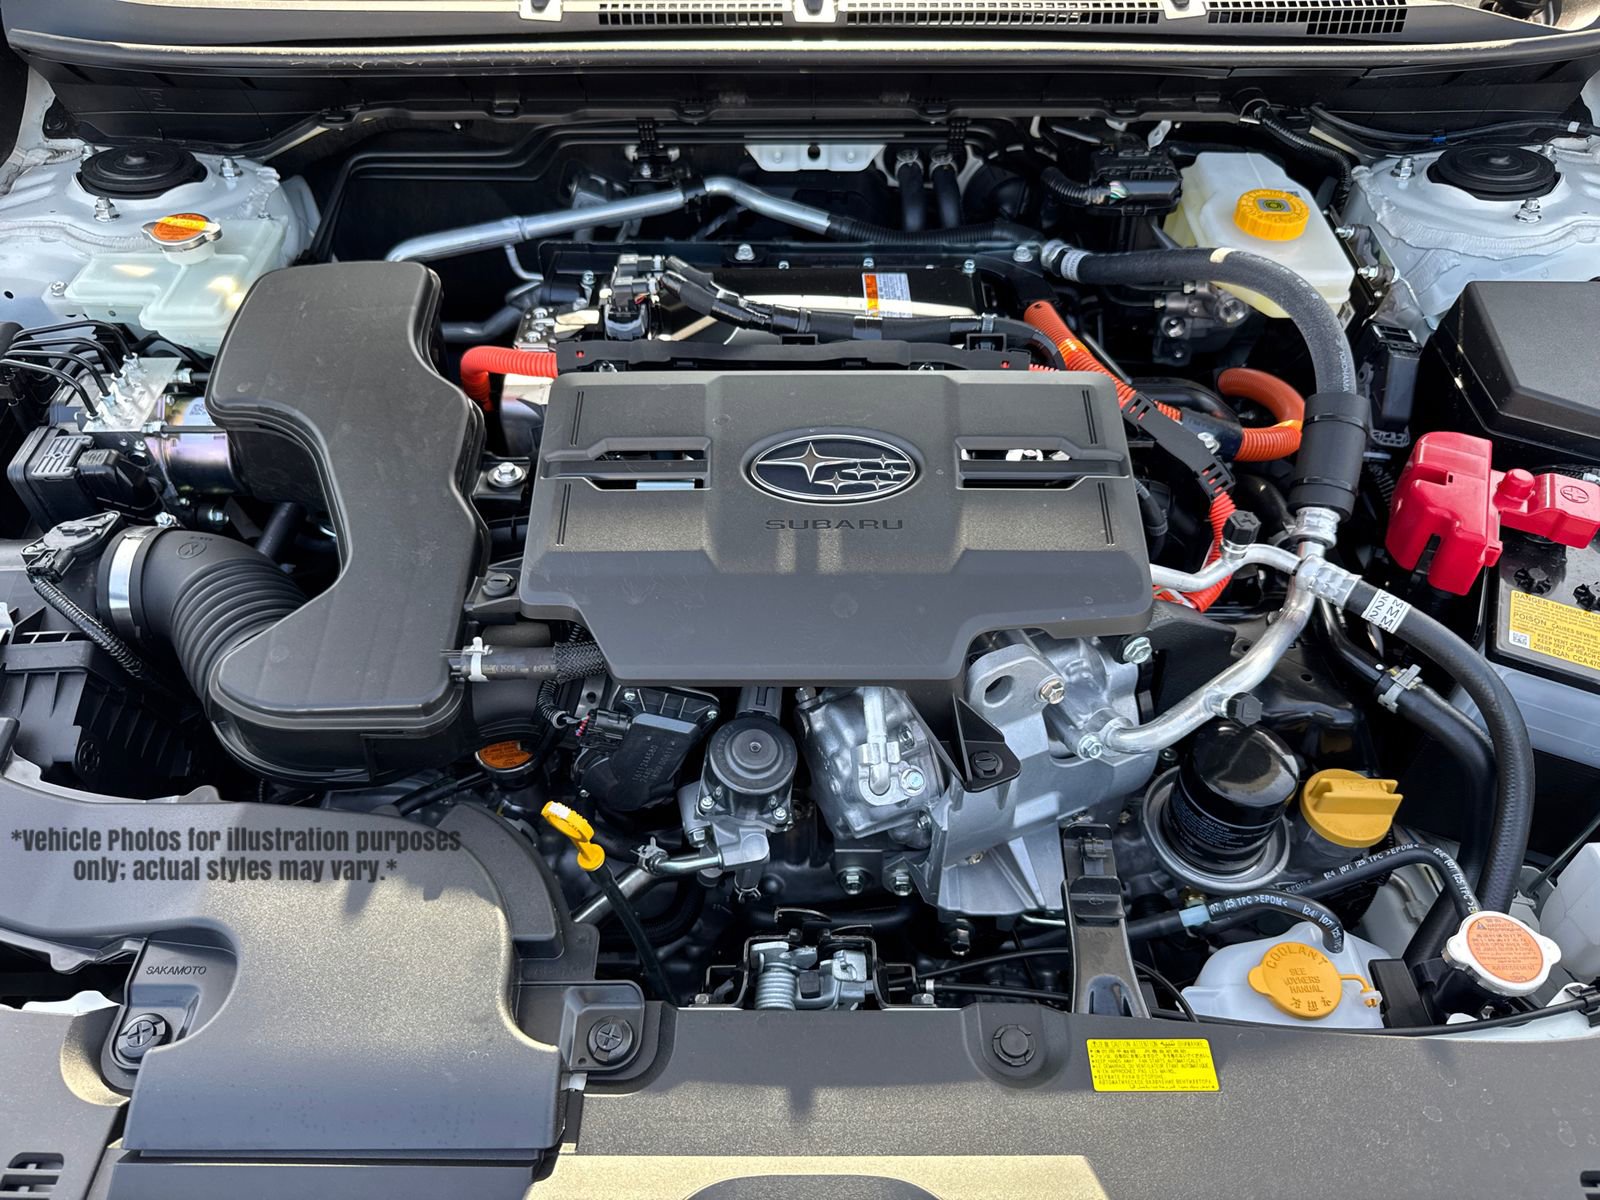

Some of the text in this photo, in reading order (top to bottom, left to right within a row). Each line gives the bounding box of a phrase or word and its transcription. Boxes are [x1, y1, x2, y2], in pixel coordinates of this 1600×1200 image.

[765, 519, 903, 530] SUBARU
[1514, 592, 1550, 607] DANGER
[1513, 612, 1547, 626] POISON
[1572, 654, 1589, 665] CCA
[1368, 852, 1383, 863] TPC
[1237, 895, 1253, 906] TPC
[1265, 944, 1328, 969] COOLANT
[146, 965, 207, 976] SAKAMOTO
